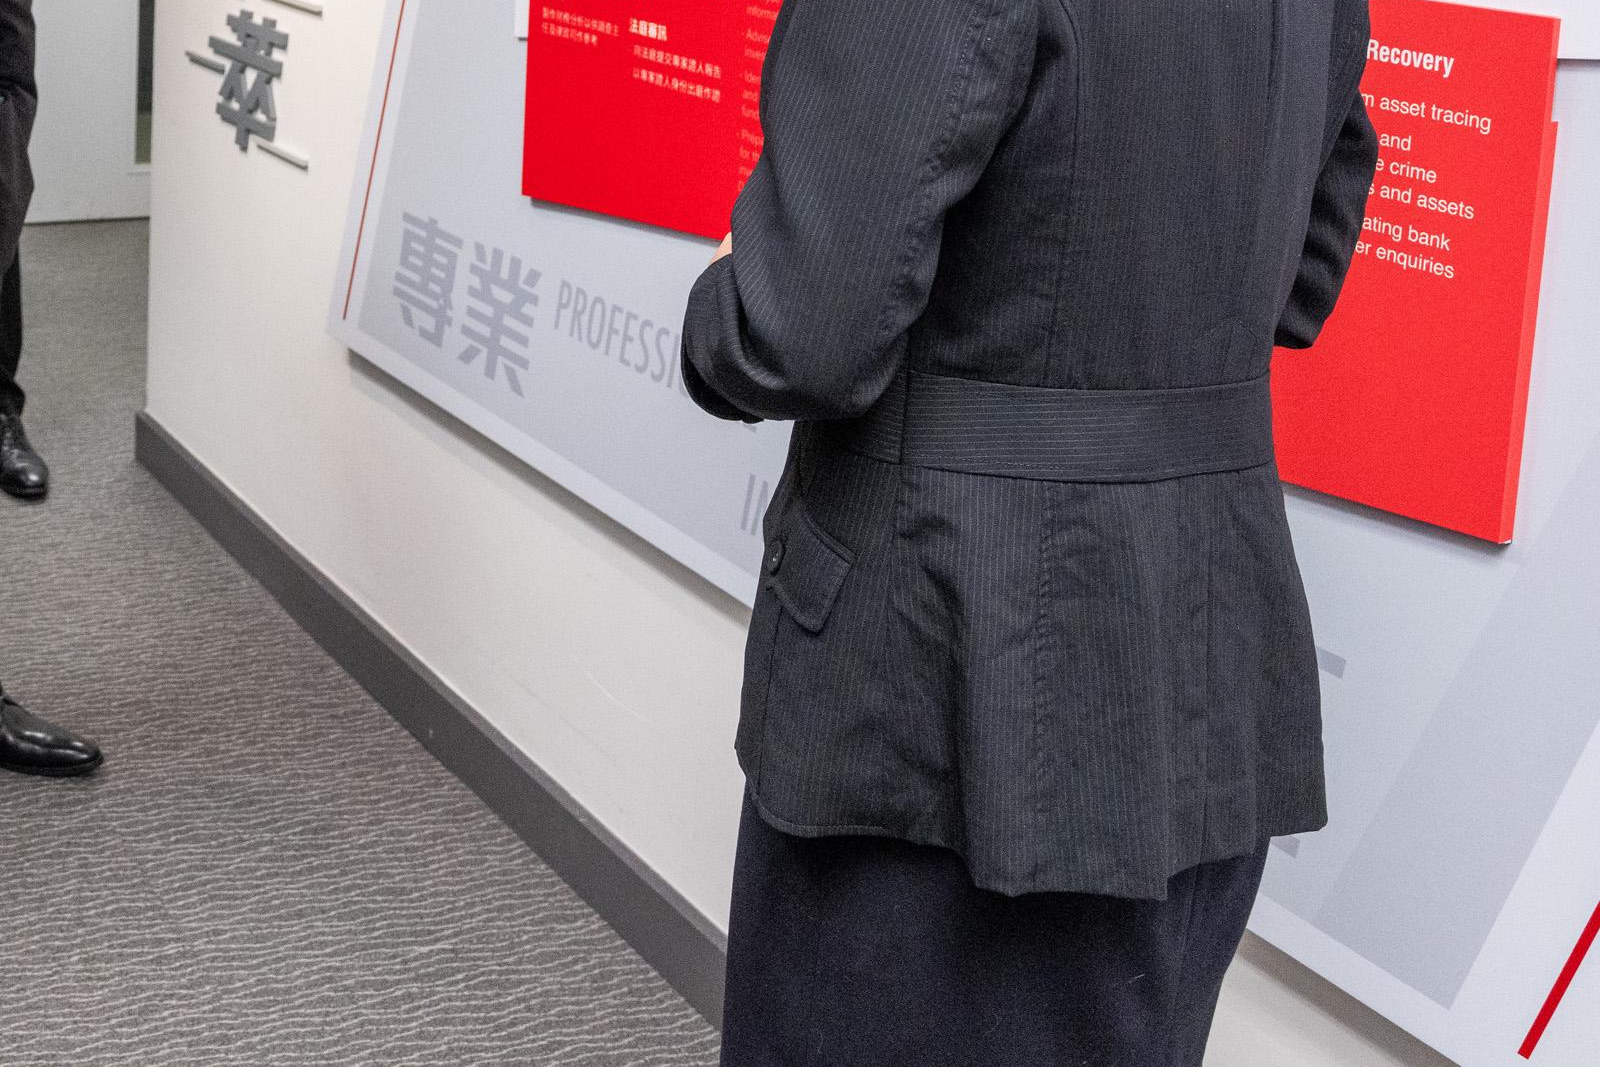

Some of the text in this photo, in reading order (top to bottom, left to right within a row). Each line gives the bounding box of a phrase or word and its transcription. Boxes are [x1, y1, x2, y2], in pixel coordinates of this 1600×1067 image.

[1366, 38, 1454, 78] Recovery
[1379, 96, 1426, 118] asset
[1431, 104, 1491, 135] tracing
[1379, 133, 1411, 151] and
[1389, 161, 1437, 183] crime
[1380, 185, 1411, 204] and
[1417, 193, 1475, 219] assets
[1362, 216, 1450, 251] ating bank
[1376, 246, 1454, 279] enquiries
[392, 211, 542, 399] 專業
[554, 280, 684, 397] PROFESSI
